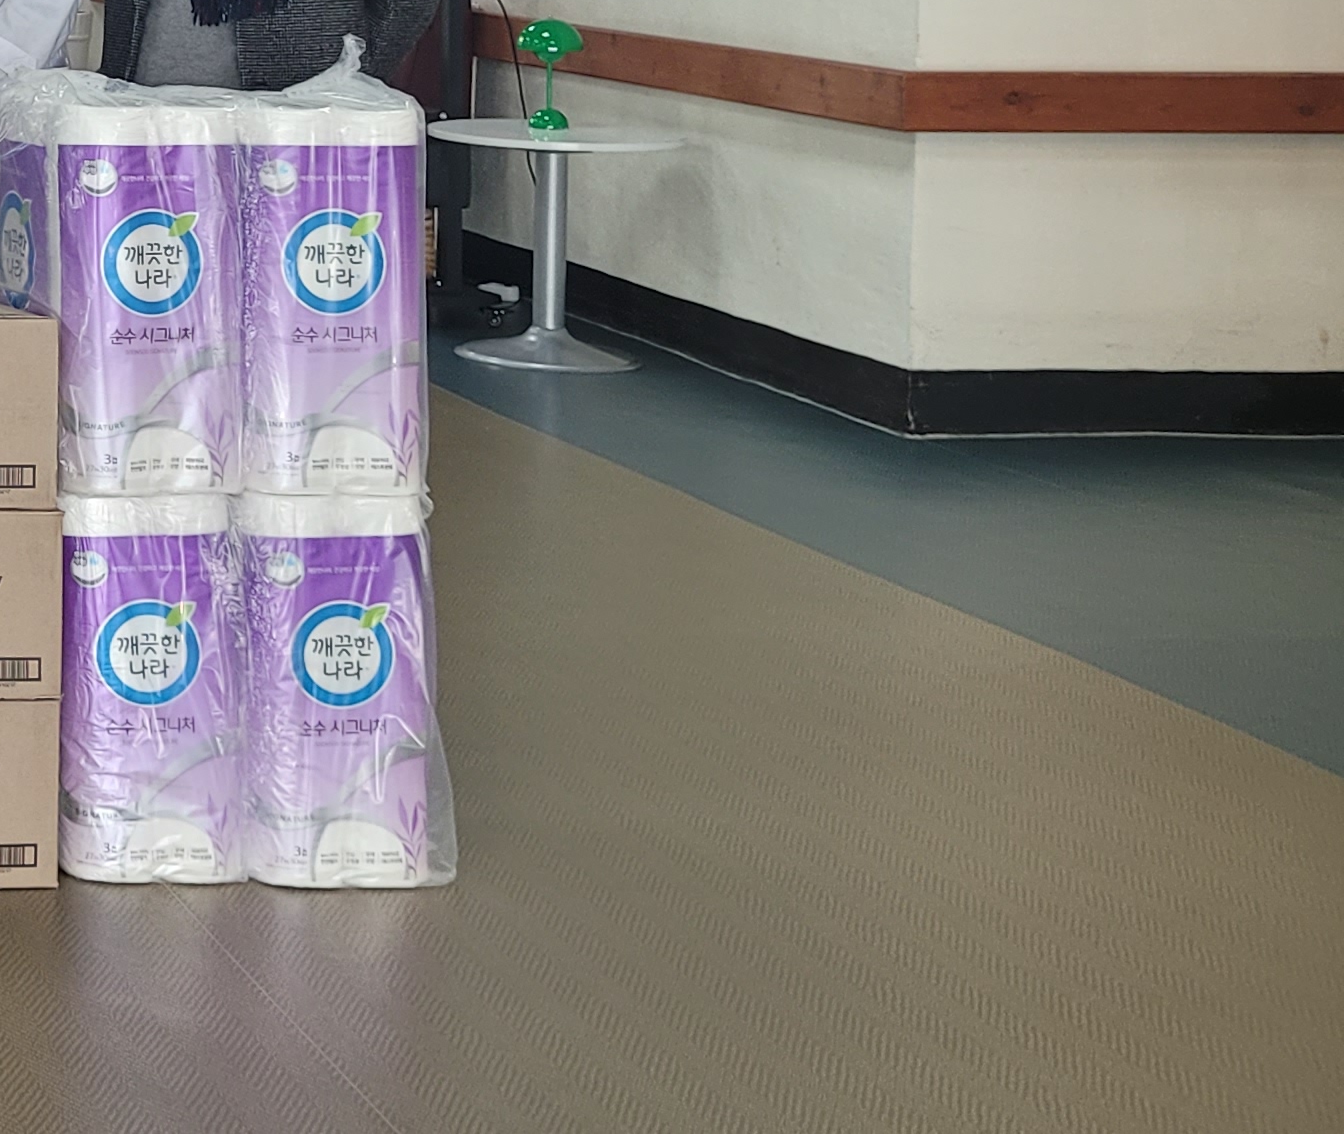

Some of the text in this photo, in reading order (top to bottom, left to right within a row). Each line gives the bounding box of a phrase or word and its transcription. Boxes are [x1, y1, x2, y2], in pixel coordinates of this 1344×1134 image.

[124, 244, 183, 265] 깨끗한
[304, 244, 365, 265] 깨끗한
[135, 268, 172, 289] 나라
[315, 268, 355, 289] 나라
[109, 327, 195, 346] 순수 시그니처
[291, 327, 378, 345] 순수 시그니처
[116, 634, 180, 657] 깨끗한
[311, 634, 373, 657] 깨끗한
[130, 659, 169, 679] 나라
[323, 661, 363, 681] 나라
[331, 719, 387, 736] 시그니처
